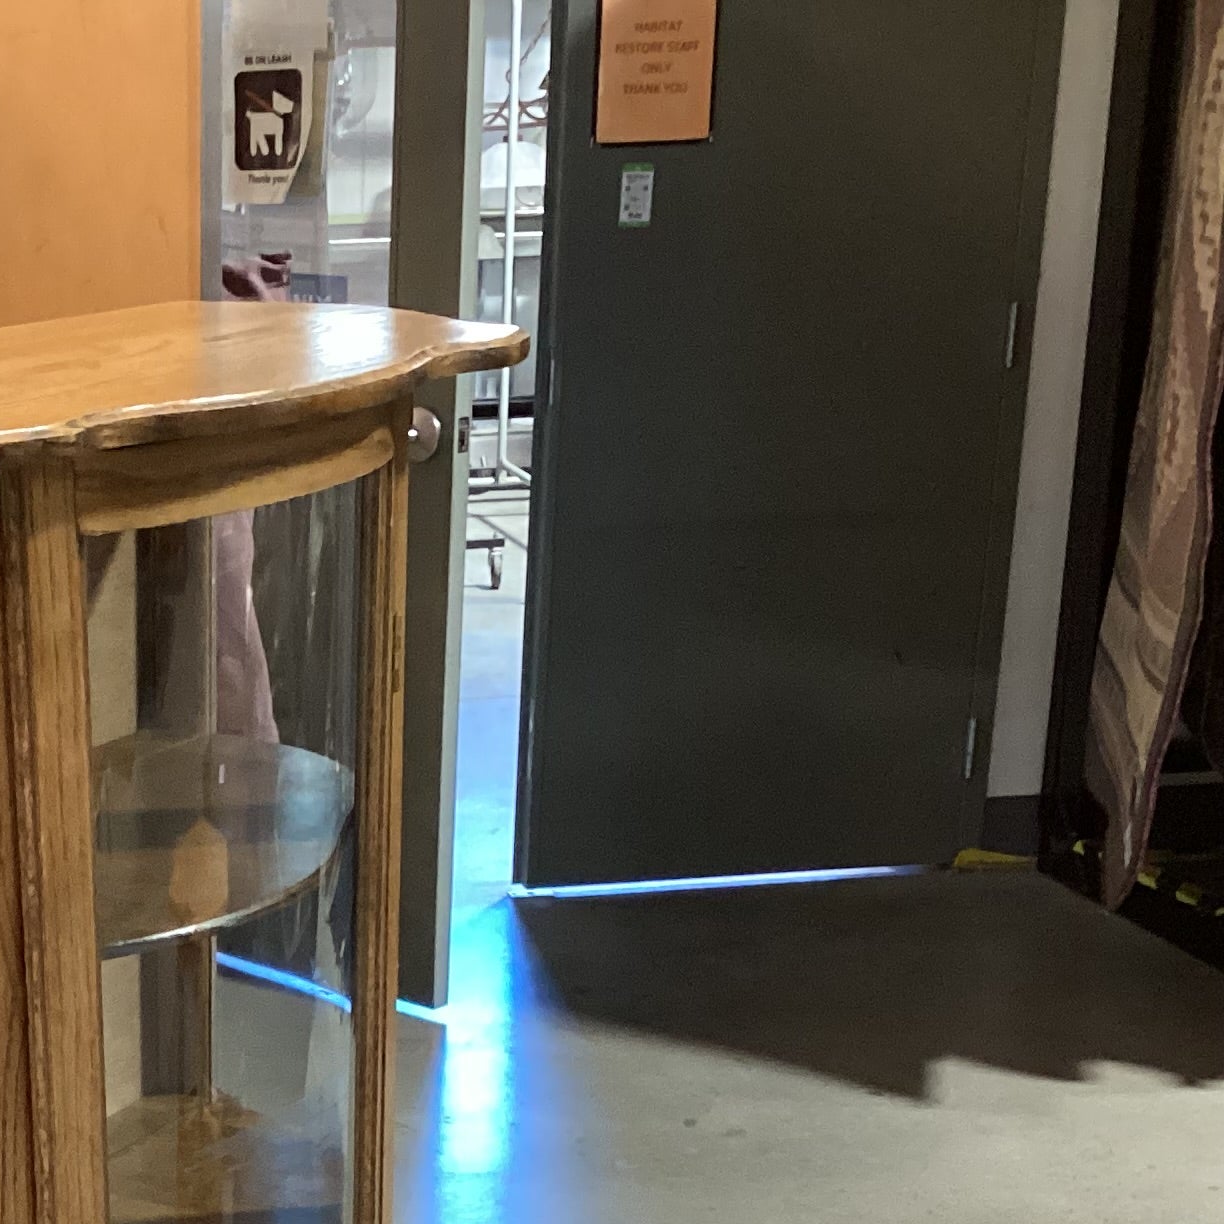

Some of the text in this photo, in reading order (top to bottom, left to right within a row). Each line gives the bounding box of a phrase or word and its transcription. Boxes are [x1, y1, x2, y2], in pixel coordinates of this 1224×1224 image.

[635, 20, 683, 32] HABITAT
[641, 62, 672, 74] ONLY
[623, 82, 688, 94] THANK YOU
